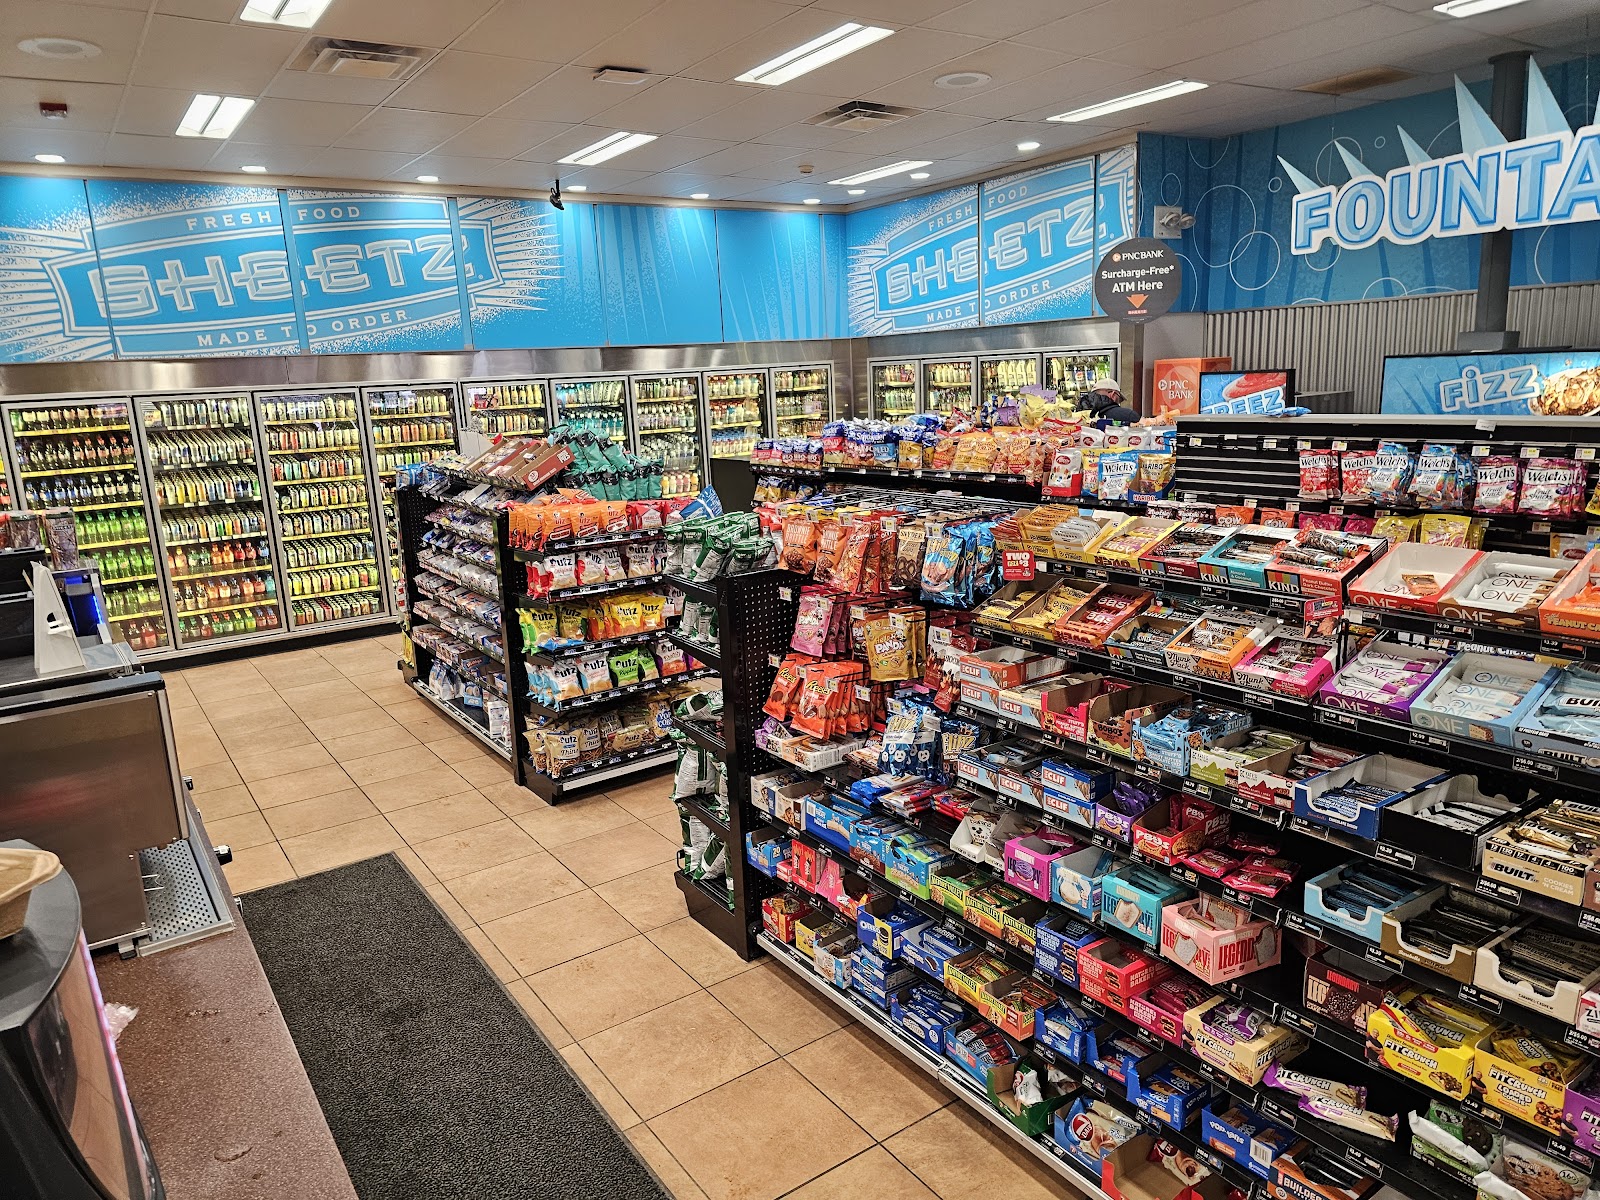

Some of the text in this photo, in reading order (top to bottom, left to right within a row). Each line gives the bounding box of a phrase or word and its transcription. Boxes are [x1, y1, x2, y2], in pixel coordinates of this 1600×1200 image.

[928, 185, 1029, 232] FRESH FOOD
[186, 205, 361, 231] FRESH FOOD
[887, 193, 1106, 304] SHEETZ
[87, 232, 470, 320] SHEETZ
[1111, 280, 1164, 293] ATM Here
[926, 308, 963, 323] MADE
[196, 329, 268, 348] MADE
[1168, 380, 1189, 390] PNC
[1168, 390, 1194, 400] BANK
[1104, 462, 1134, 474] Welch's
[1301, 457, 1327, 466] Welch's
[1344, 458, 1373, 468] Welch's
[1376, 456, 1407, 466] Welch's
[1420, 456, 1451, 468] Welch's
[1478, 466, 1516, 480] Welch's
[1528, 469, 1568, 482] Welch's
[1133, 494, 1156, 502] HARIBO
[1006, 552, 1030, 560] TWO
[1200, 572, 1229, 585] KIND
[1491, 578, 1533, 590] ONE
[1268, 580, 1300, 594] KIND
[1314, 584, 1338, 592] Chocolate
[1353, 594, 1398, 609] ONE
[1481, 590, 1528, 603] ONE
[1442, 607, 1494, 623] ONE
[1547, 618, 1588, 630] PEANUT
[873, 640, 906, 655] PANDA
[778, 667, 798, 684] Reese's
[965, 666, 981, 677] CLIF
[1235, 672, 1264, 685] Munk
[1358, 664, 1397, 681] ONE
[805, 679, 832, 695] Reese's
[1474, 672, 1521, 688] ONE
[967, 687, 982, 699] CLIF
[1341, 688, 1383, 700] ONE
[1456, 683, 1499, 699] ONE
[1005, 699, 1022, 714] CLIF
[1324, 695, 1369, 713] ONE
[1097, 724, 1123, 737] BOBO'S
[1414, 712, 1465, 735] ONE
[1544, 750, 1586, 764] BUILT
[962, 763, 979, 777] CLIF
[1046, 770, 1066, 785] CLIF
[1003, 779, 1023, 793] CLIF
[1050, 798, 1070, 812] CLIF
[1494, 863, 1535, 881] BUILT
[1561, 865, 1574, 873] 100
[931, 875, 963, 899] NATURE VALLEY
[1543, 877, 1574, 890] COOKIES
[1550, 885, 1574, 896] CREAM
[983, 903, 1001, 922] VALLEY
[859, 920, 881, 933] OREO
[962, 974, 977, 994] VALLEY
[1130, 972, 1154, 988] BAKERY
[1518, 1037, 1542, 1059] LOADED
[1497, 1083, 1532, 1104] LOADED
[1073, 1114, 1087, 1138] 7
